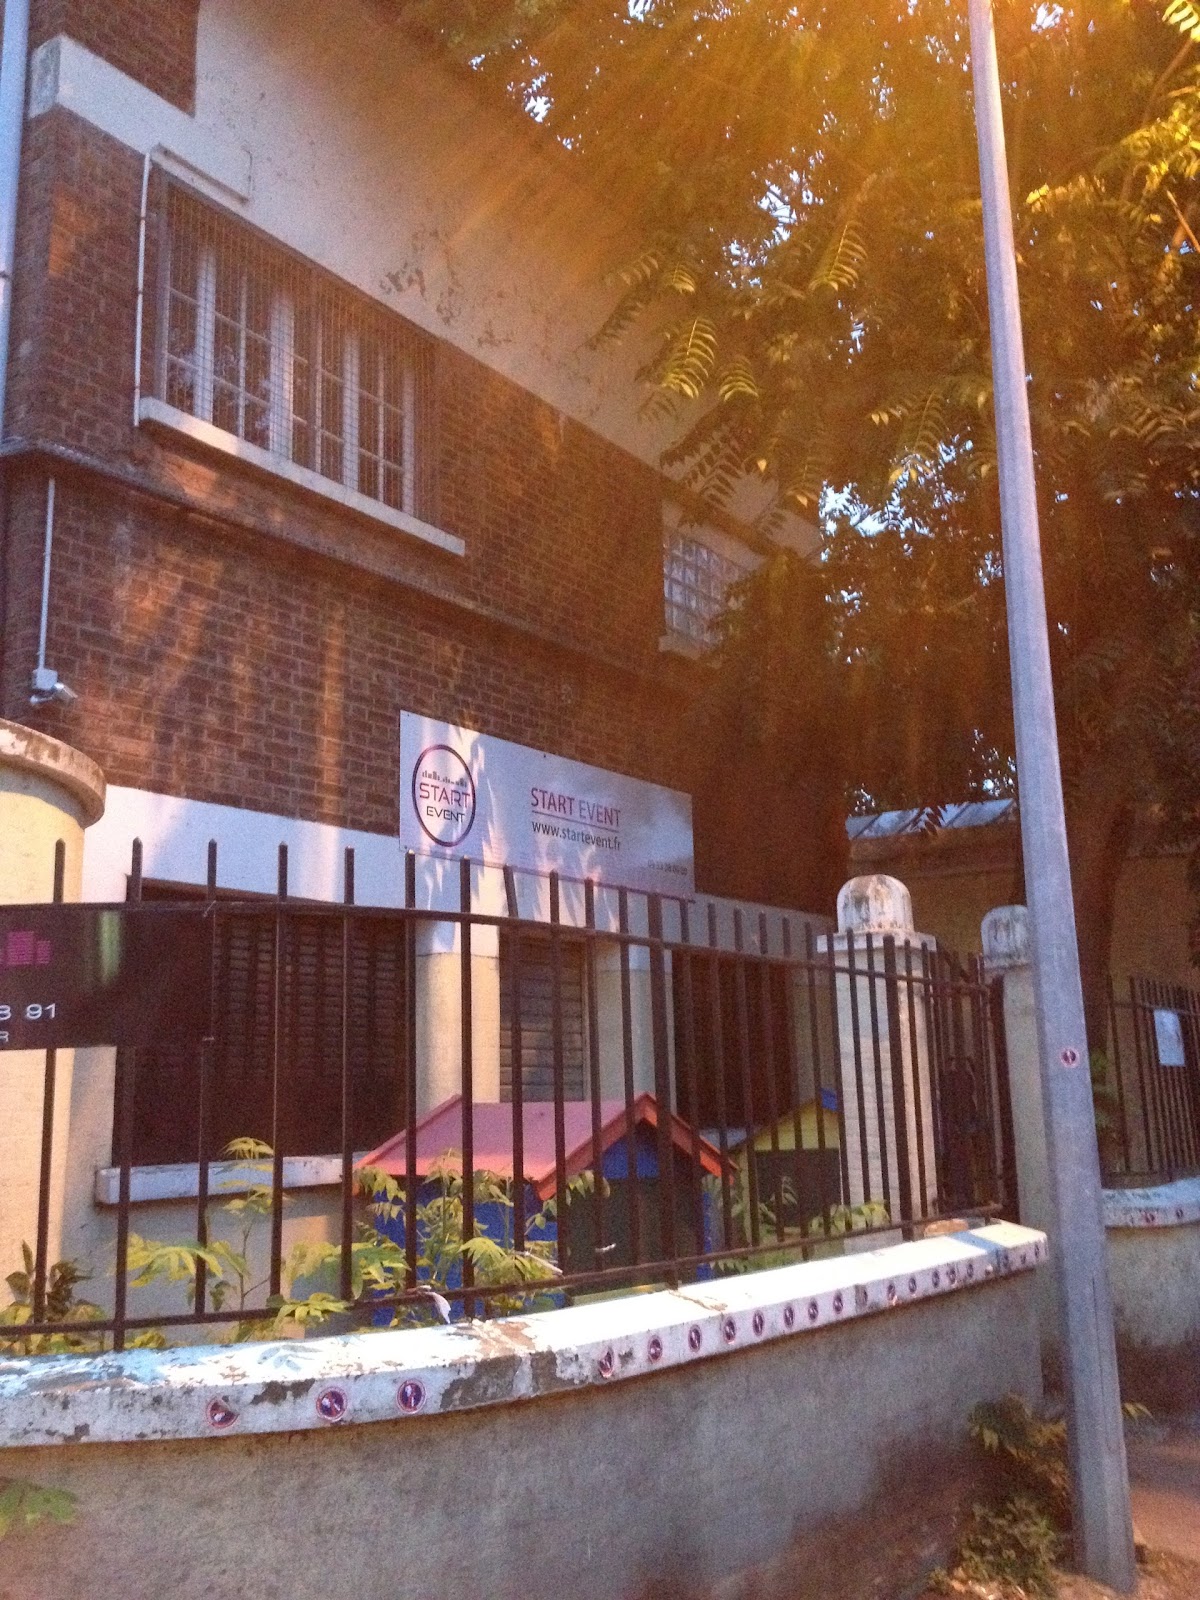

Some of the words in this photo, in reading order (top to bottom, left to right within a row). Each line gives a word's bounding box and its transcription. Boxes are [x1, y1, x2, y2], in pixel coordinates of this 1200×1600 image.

[419, 782, 471, 808] START
[531, 787, 575, 815] START
[579, 799, 620, 827] EVENT
[426, 805, 466, 823] EVENT
[531, 821, 621, 851] www.startevent.fr
[26, 1003, 56, 1020] 91
